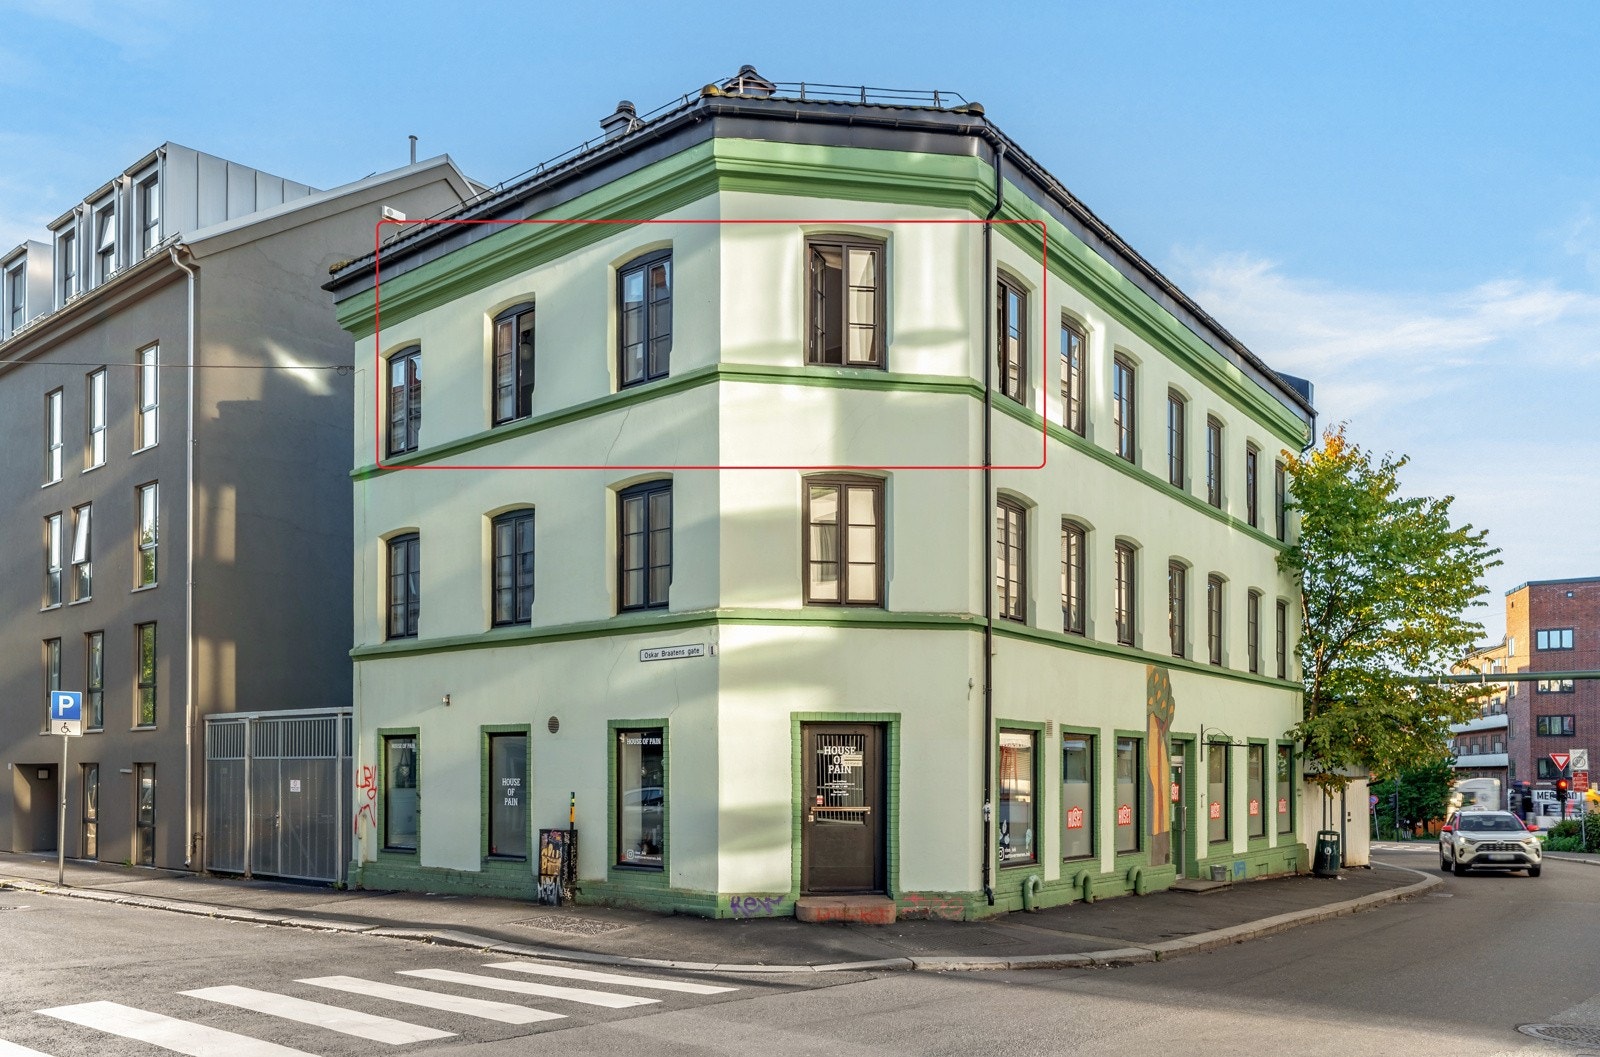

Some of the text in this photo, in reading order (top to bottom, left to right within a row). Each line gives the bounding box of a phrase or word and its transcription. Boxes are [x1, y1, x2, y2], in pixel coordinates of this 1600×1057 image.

[644, 647, 700, 659] Oskar Braatens gate
[58, 695, 75, 717] P
[823, 745, 857, 755] HOUSE
[828, 765, 852, 774] PAIN
[502, 777, 521, 786] HOUSE
[507, 788, 515, 796] OF
[504, 797, 518, 806] PAIN
